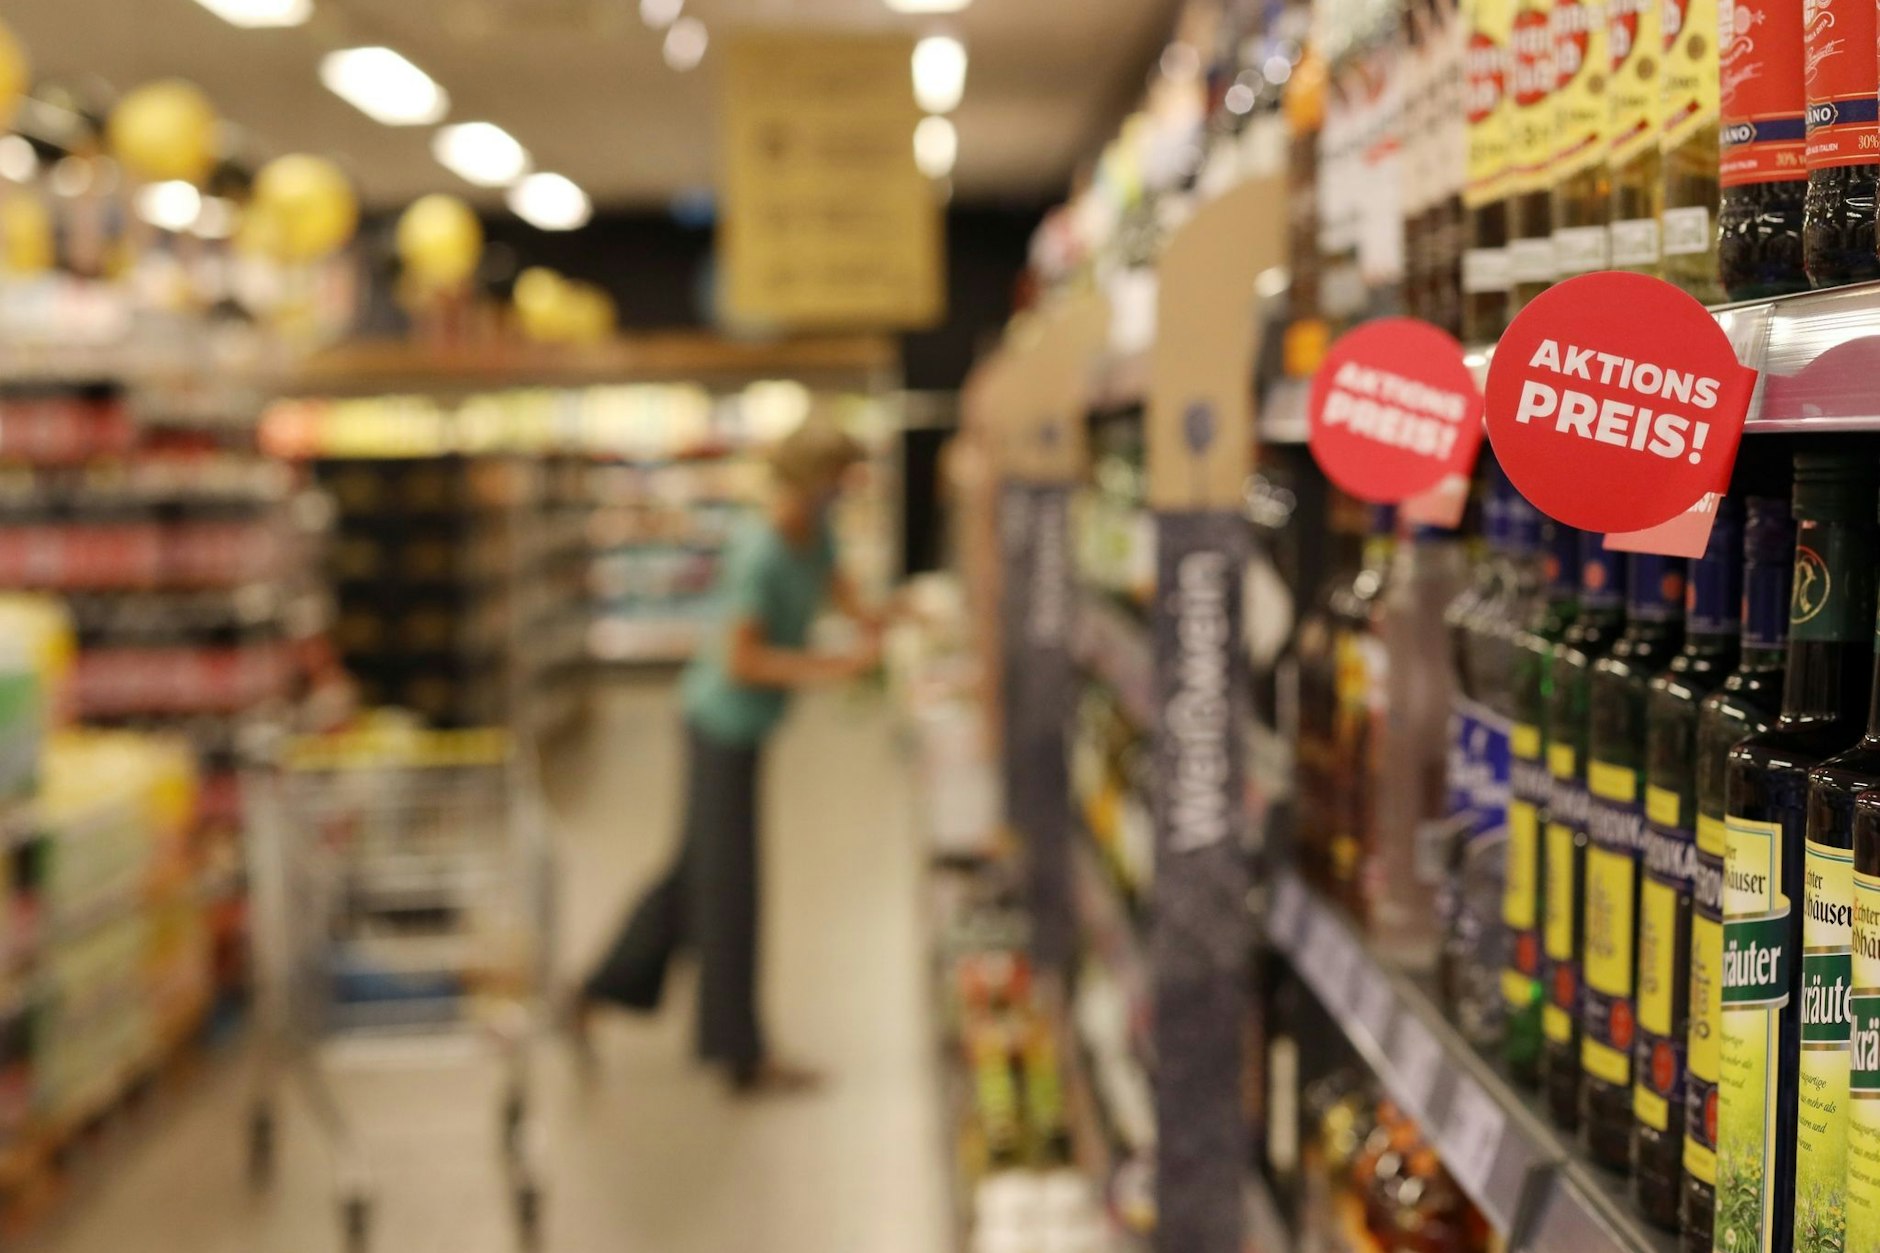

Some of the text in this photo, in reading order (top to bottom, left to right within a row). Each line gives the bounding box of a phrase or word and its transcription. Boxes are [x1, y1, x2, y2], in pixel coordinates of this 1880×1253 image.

[1334, 361, 1466, 423] AKTIONS
[1528, 339, 1721, 409] AKTIONS
[1322, 388, 1458, 461] PREIS!
[1515, 380, 1710, 465] PREIS!
